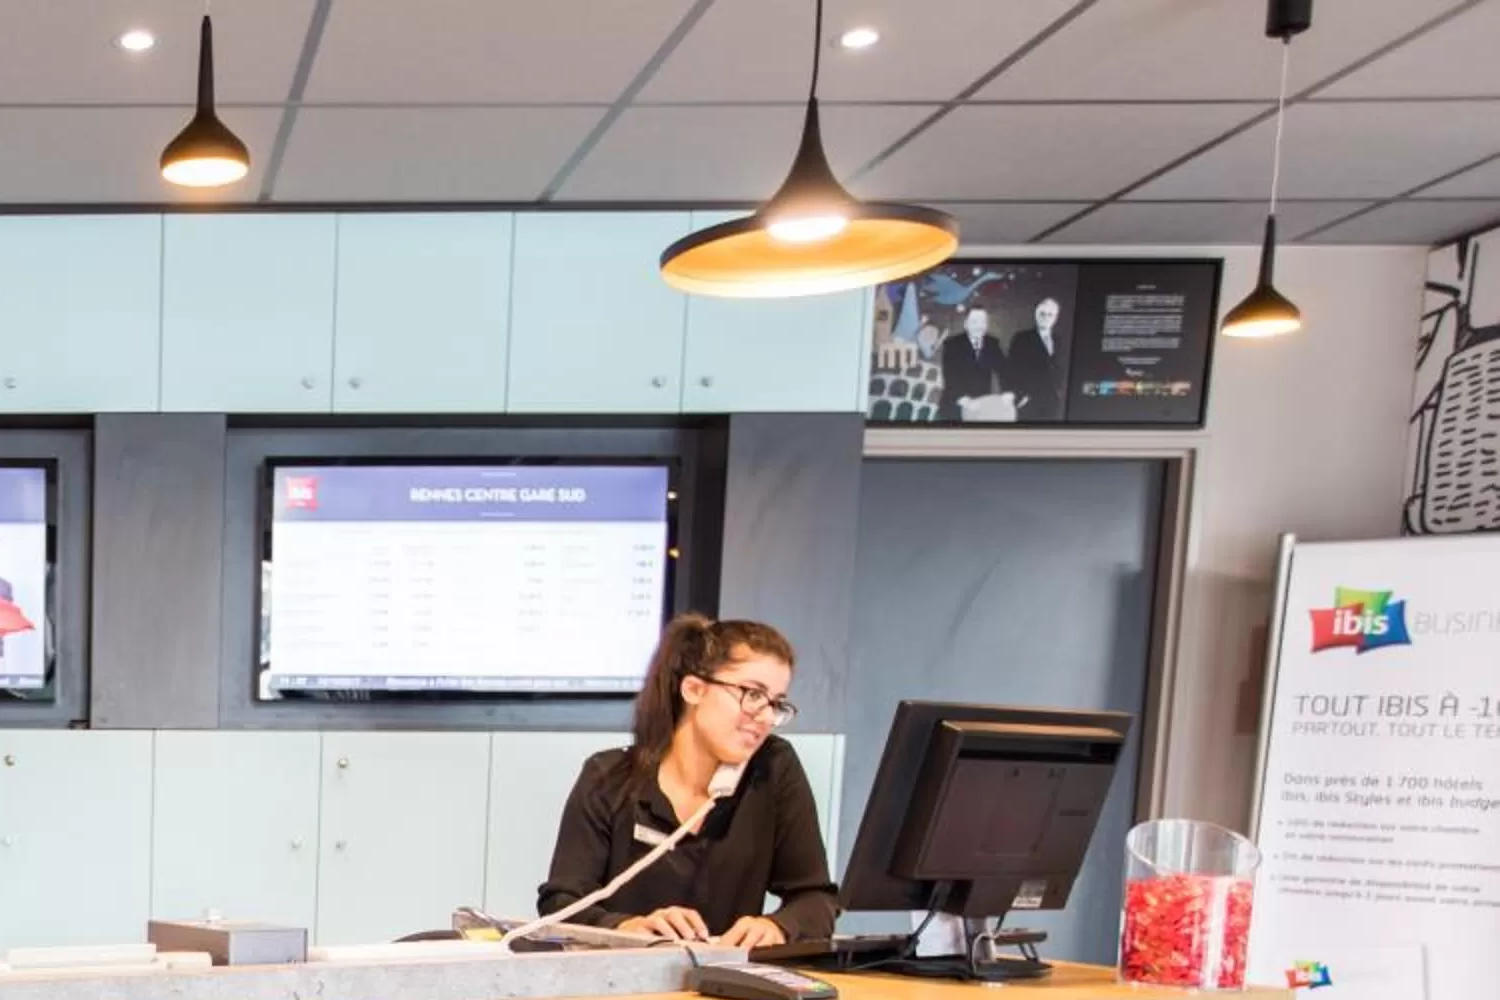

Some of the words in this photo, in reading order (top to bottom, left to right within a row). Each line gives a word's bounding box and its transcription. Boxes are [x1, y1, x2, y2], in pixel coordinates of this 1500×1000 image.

[464, 487, 518, 503] CENTRE
[558, 488, 586, 503] SUD
[1332, 609, 1390, 636] ibis
[1414, 610, 1500, 635] BUSIN
[1293, 694, 1371, 717] TOUT
[1377, 695, 1429, 717] IBIS
[1438, 689, 1460, 716] À
[1388, 722, 1437, 738] TOUT
[1445, 723, 1466, 739] LE
[1283, 772, 1320, 785] Dans
